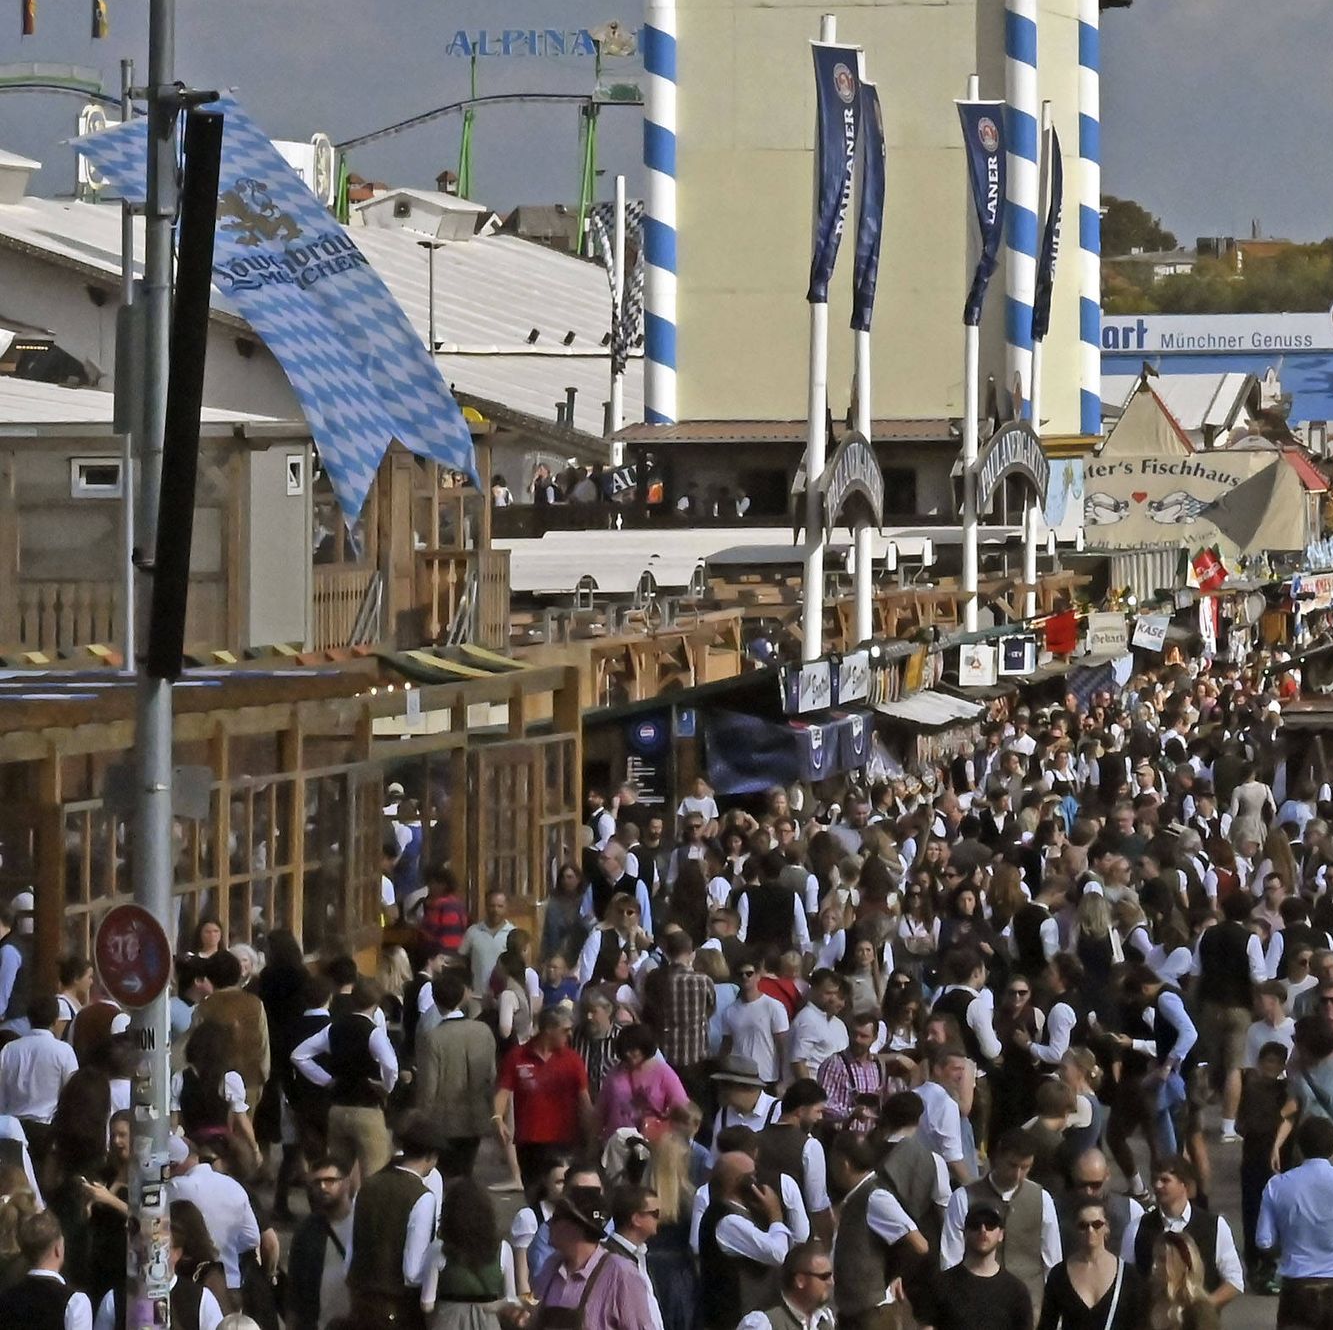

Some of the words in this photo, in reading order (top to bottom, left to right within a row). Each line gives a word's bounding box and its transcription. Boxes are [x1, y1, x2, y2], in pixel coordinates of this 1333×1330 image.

[448, 29, 598, 57] ALPINA
[1160, 331, 1245, 349] Münchner
[1251, 331, 1314, 349] Genuss
[1083, 461, 1133, 480] ter's
[1140, 458, 1241, 488] Fischhaus
